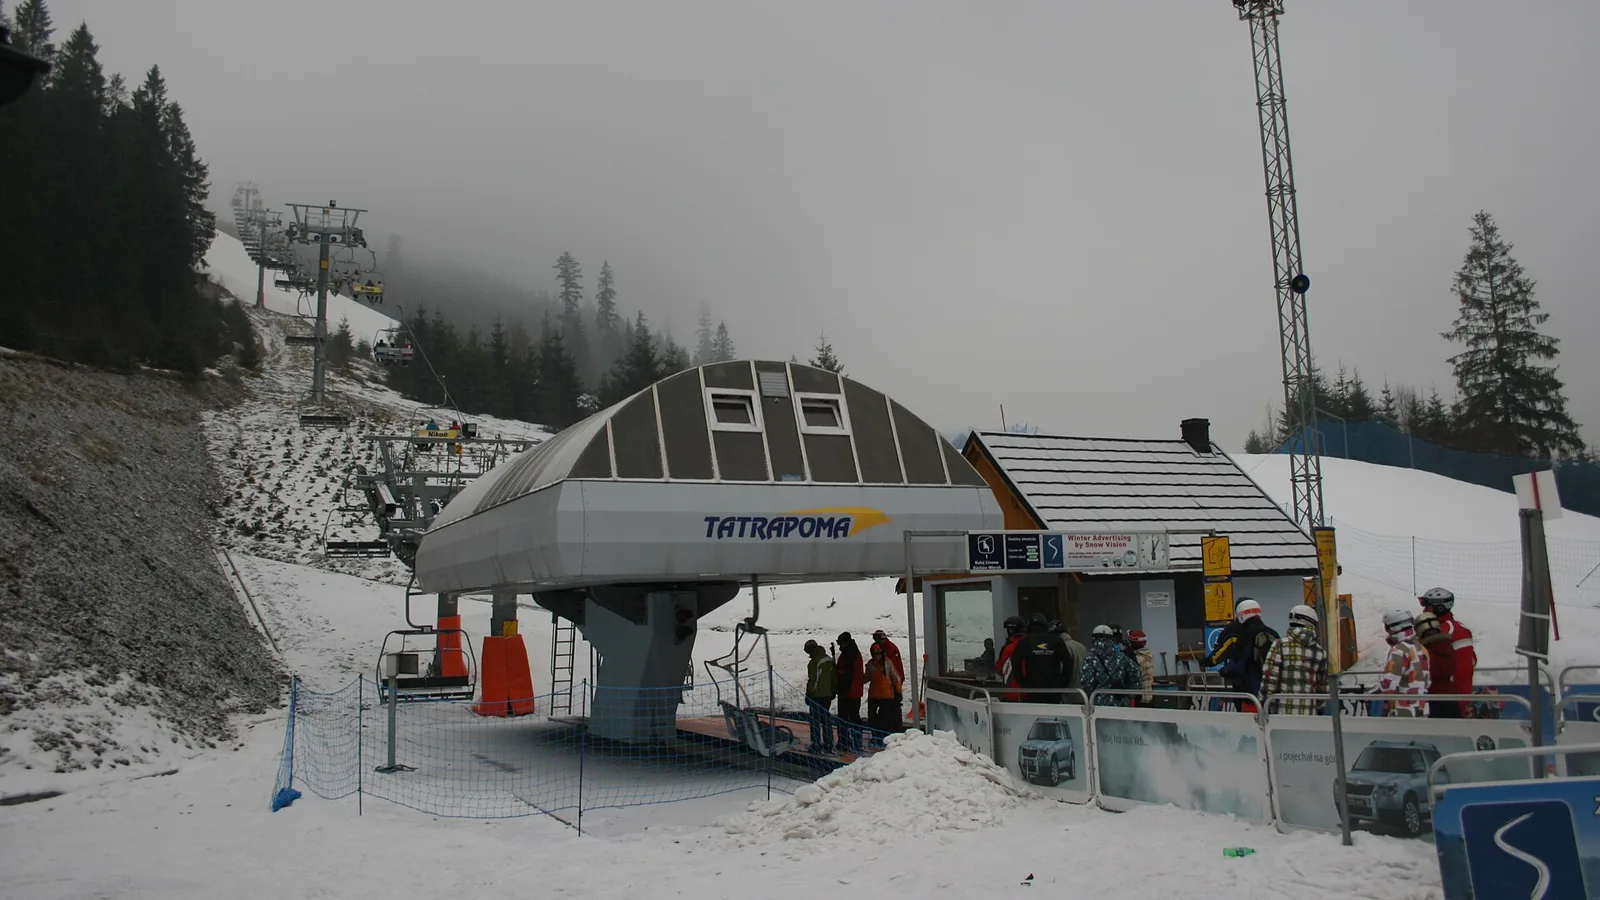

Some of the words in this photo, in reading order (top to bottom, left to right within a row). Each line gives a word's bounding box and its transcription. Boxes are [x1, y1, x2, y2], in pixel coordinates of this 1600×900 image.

[704, 516, 851, 540] TATRAPOMA
[1283, 750, 1313, 764] pojechał
[1314, 754, 1323, 762] na
[1324, 753, 1337, 766] gór
